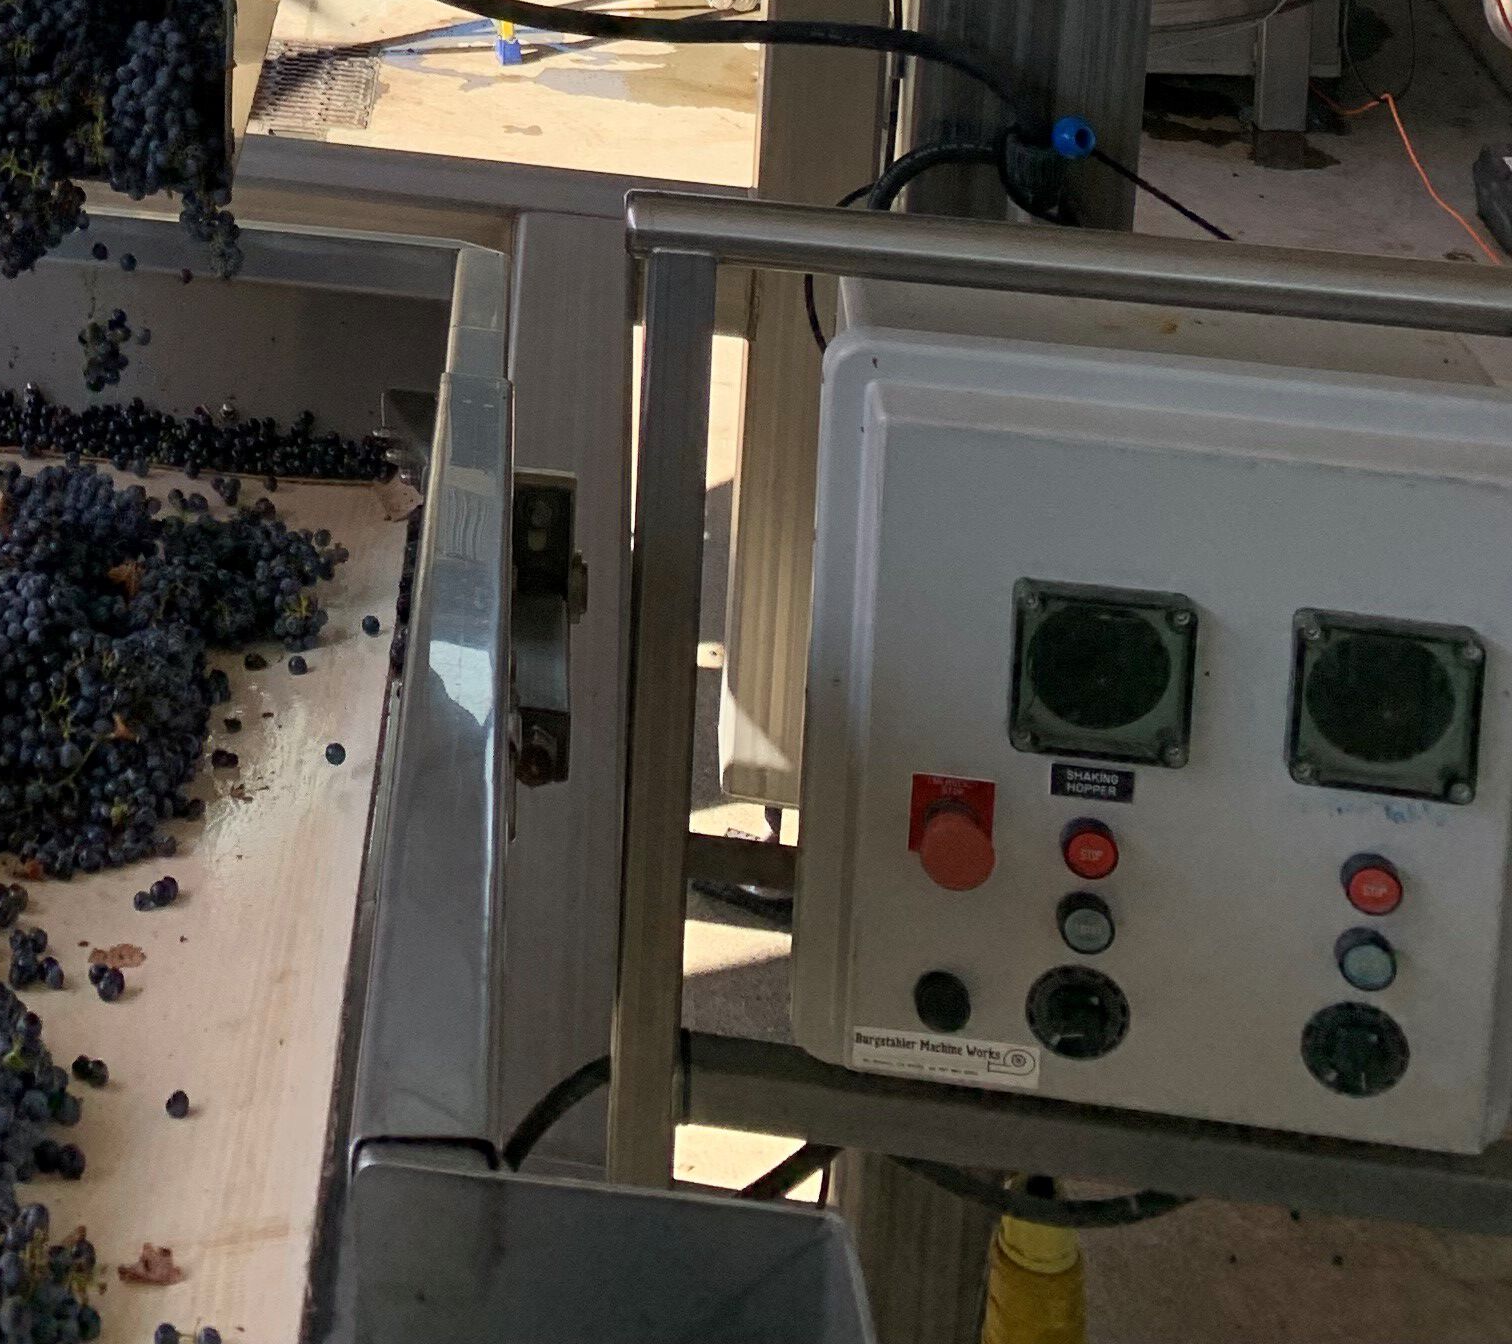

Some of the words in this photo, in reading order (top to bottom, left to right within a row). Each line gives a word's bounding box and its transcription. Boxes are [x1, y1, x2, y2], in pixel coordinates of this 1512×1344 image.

[1066, 769, 1119, 785] SHAKING
[1066, 782, 1117, 796] HOPPER
[855, 1032, 917, 1050] Burgstahler
[919, 1039, 963, 1056] Machine
[966, 1045, 1001, 1060] Works
